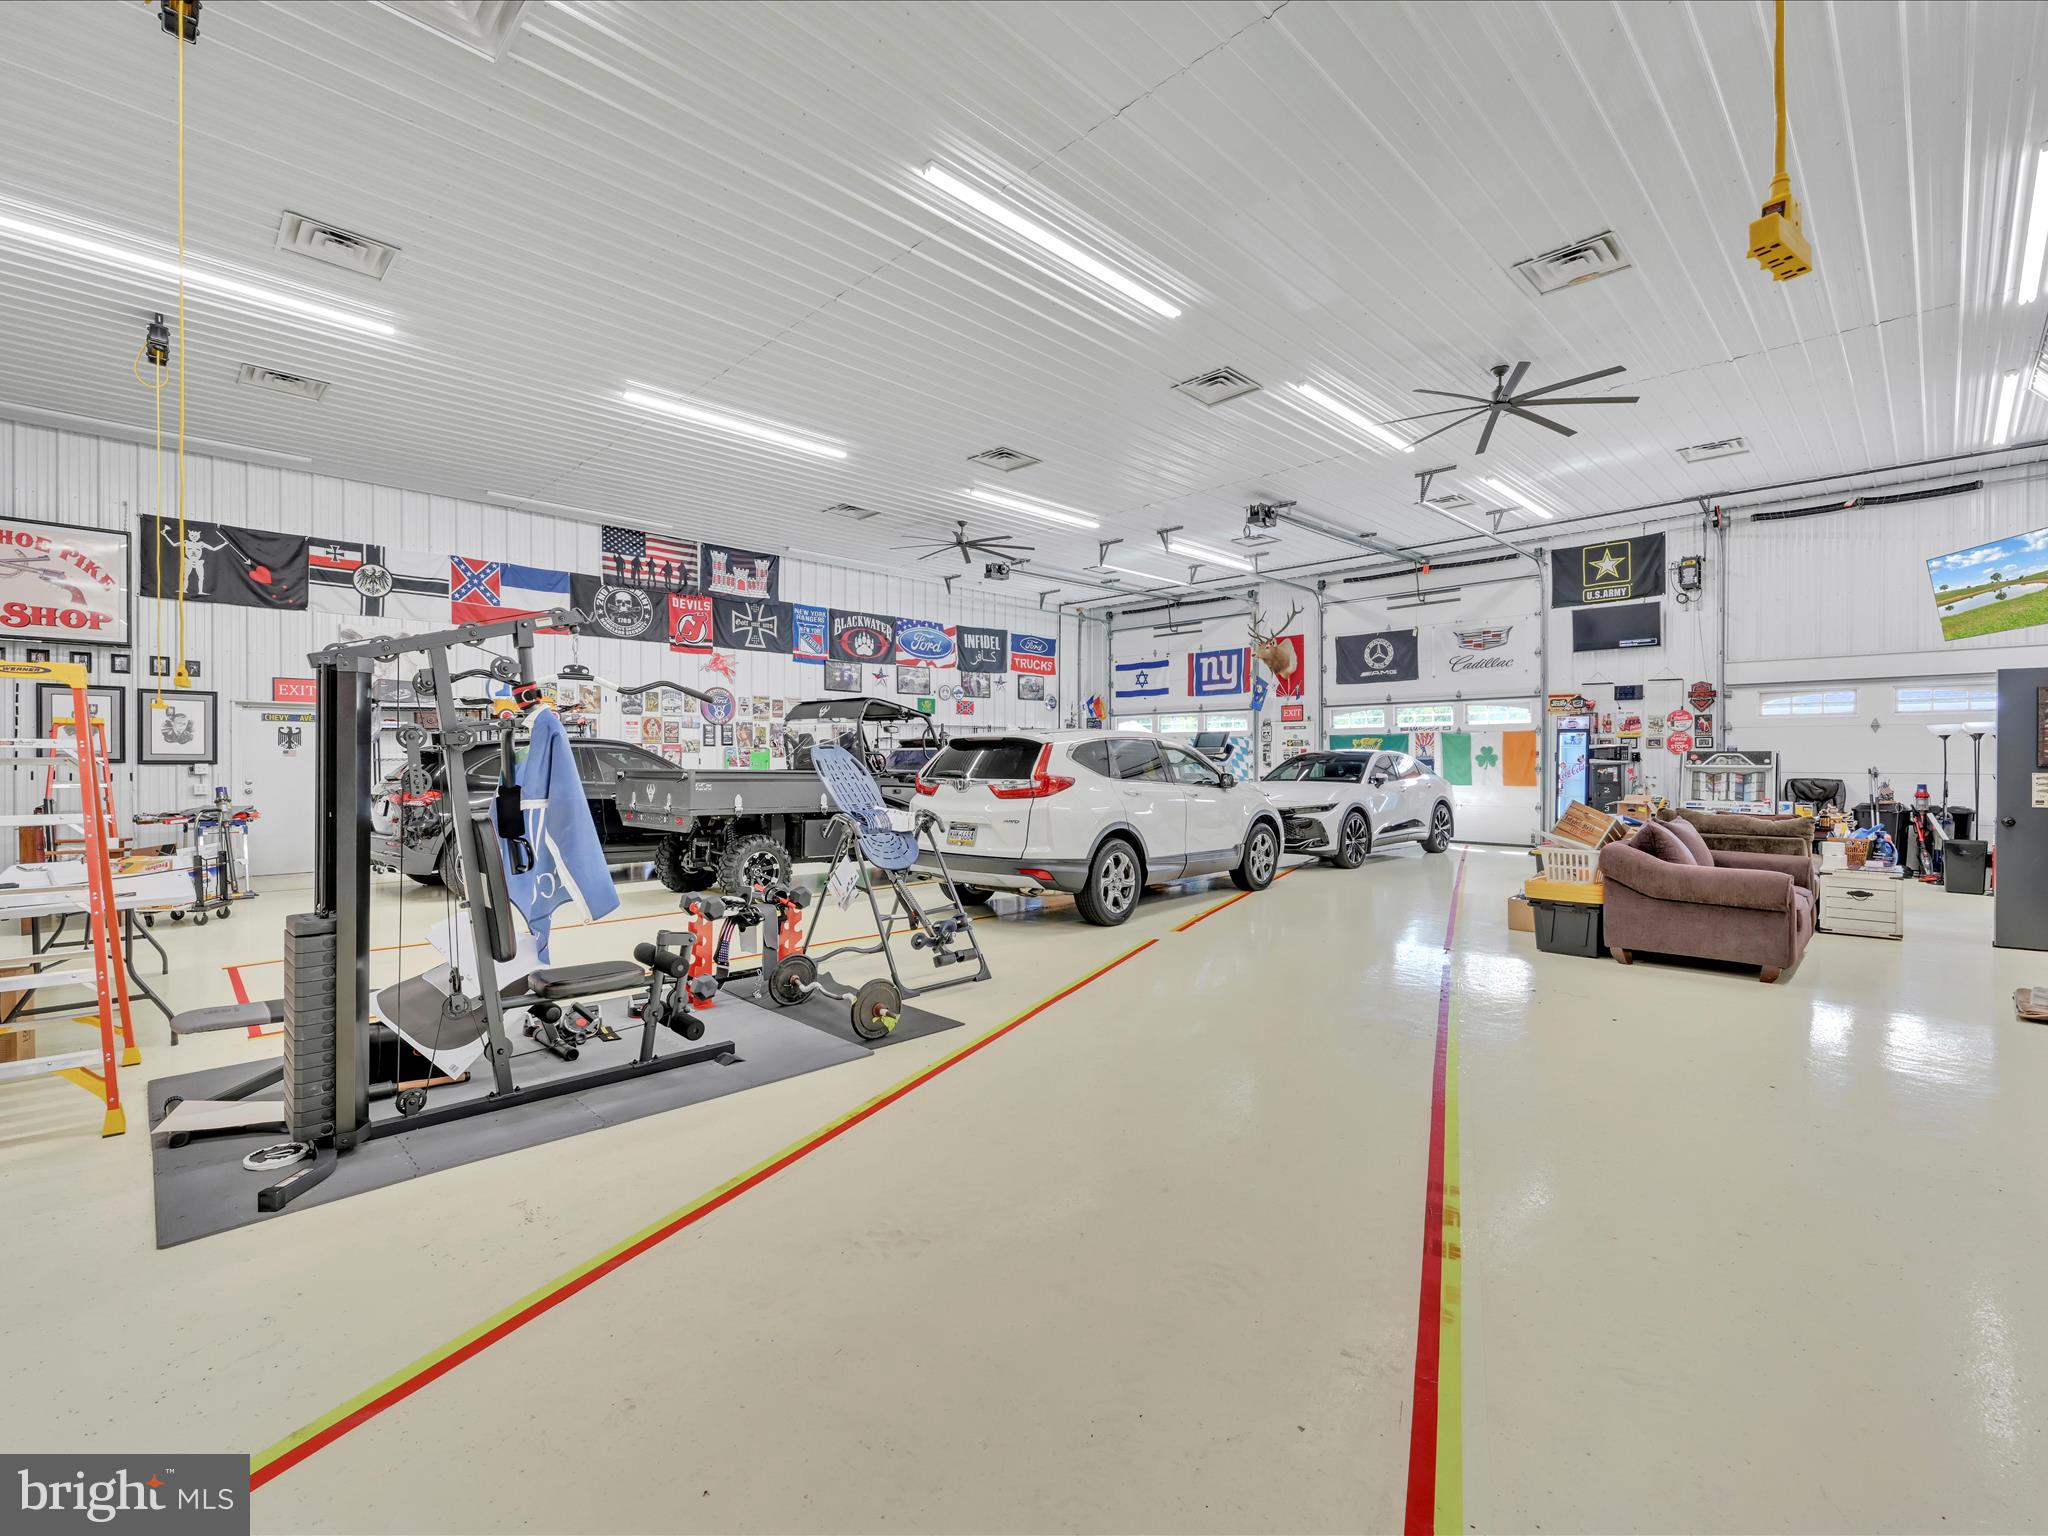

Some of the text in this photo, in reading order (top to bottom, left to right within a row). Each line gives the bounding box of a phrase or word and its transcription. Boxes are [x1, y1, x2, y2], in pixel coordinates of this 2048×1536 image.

[59, 549, 116, 591] PIKE
[672, 597, 711, 611] DEVILS
[0, 602, 113, 630] SHOP
[794, 608, 809, 616] NEW
[797, 614, 825, 623] RANGERS
[834, 616, 892, 642] BLACKWATER
[911, 632, 943, 653] Ford
[964, 634, 1001, 650] INFIDEL
[1024, 640, 1043, 650] Ford
[2, 665, 41, 673] WERNER
[1013, 657, 1053, 671] TRUCKS
[1449, 655, 1514, 673] Cadillac
[1200, 653, 1238, 691] ny
[279, 684, 316, 697] EXIT
[264, 713, 314, 722] CHEVY AVE
[1283, 709, 1302, 717] EXIT
